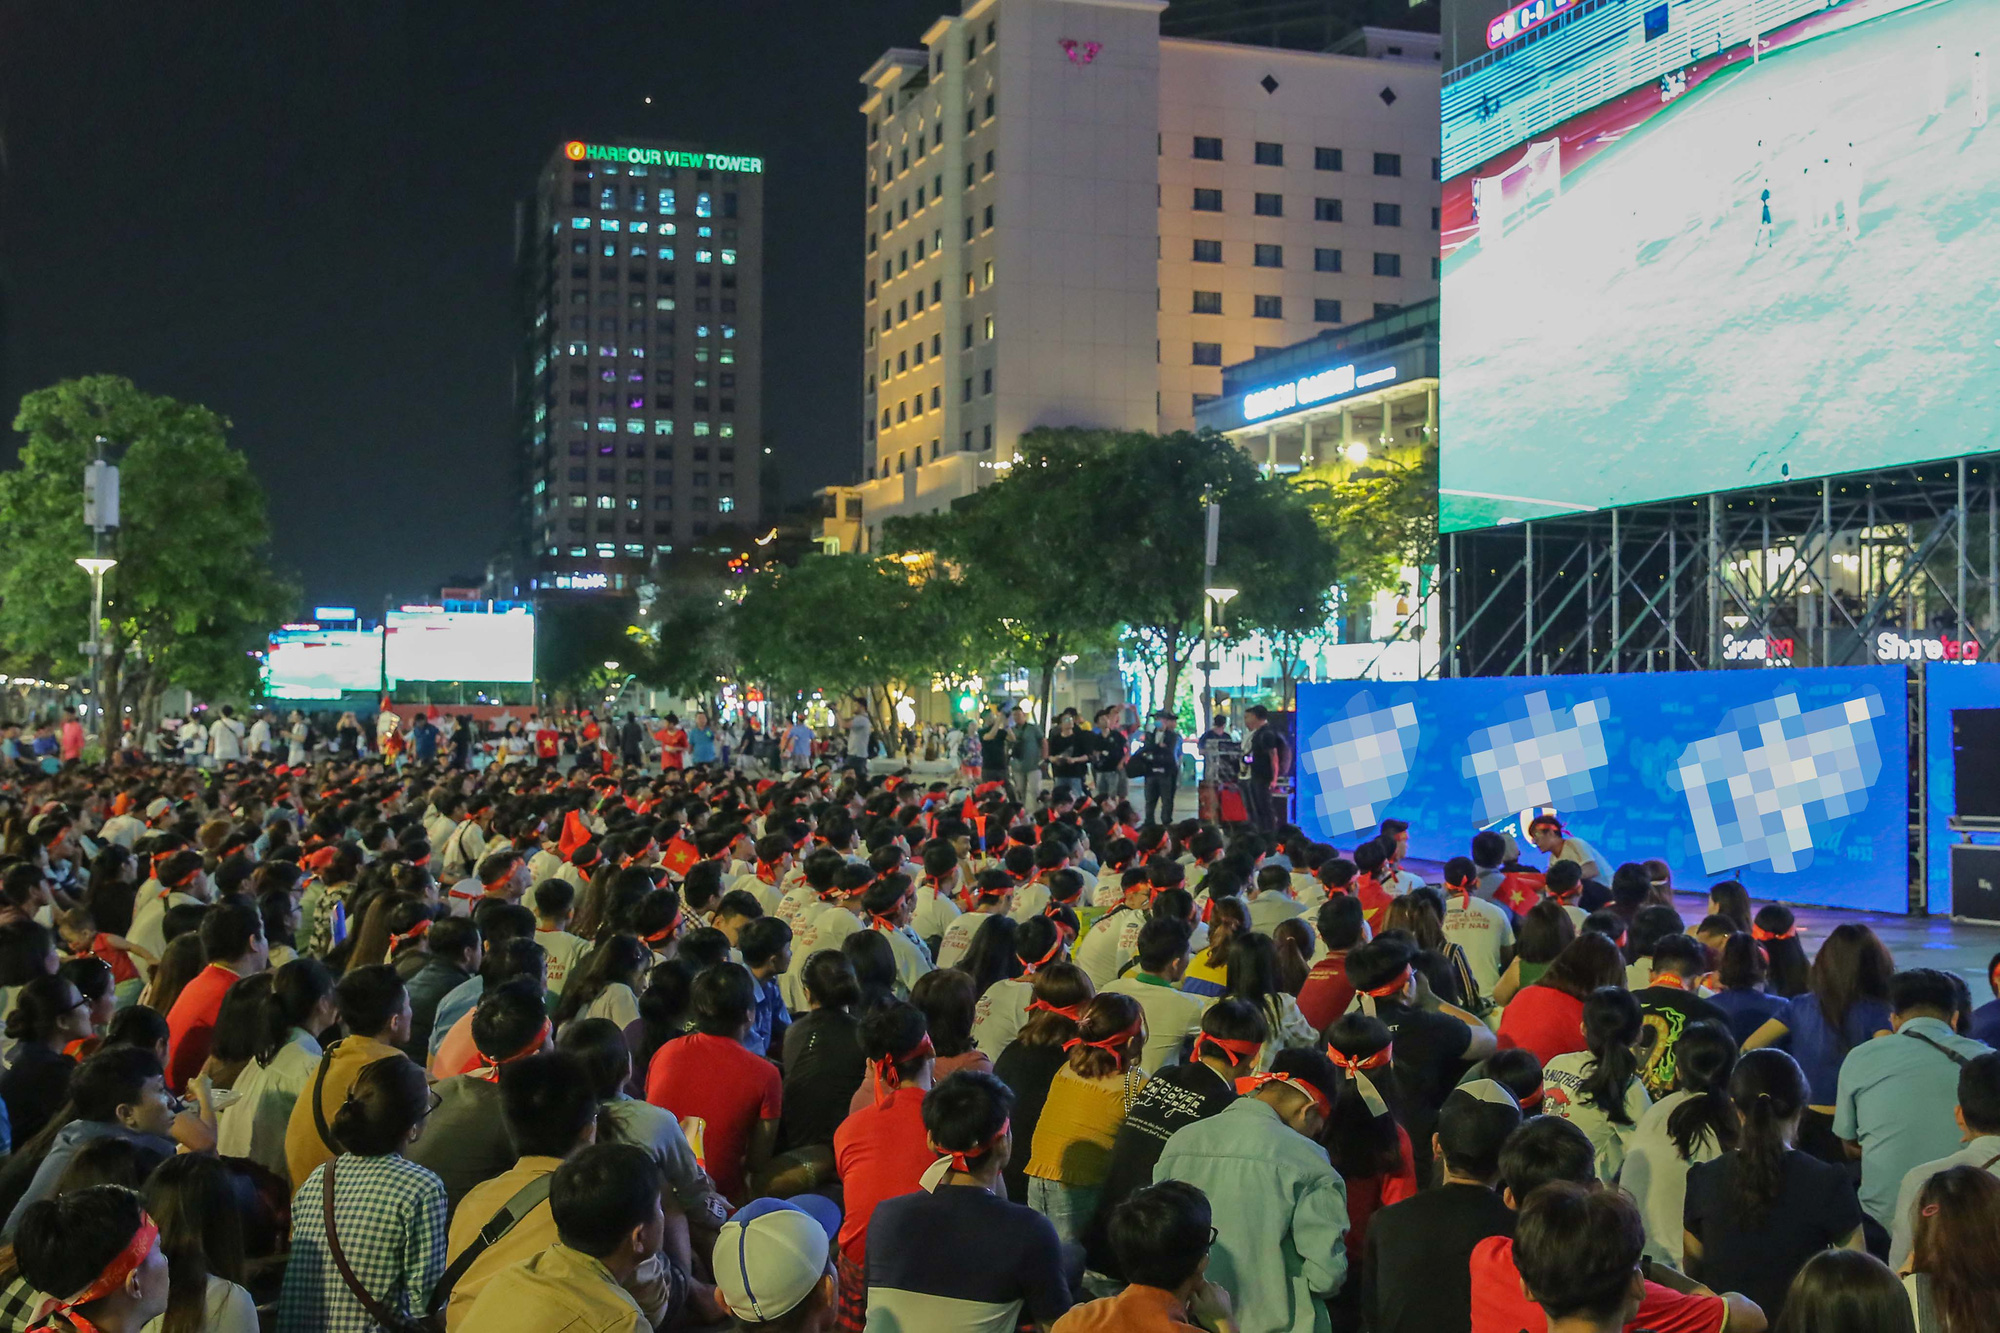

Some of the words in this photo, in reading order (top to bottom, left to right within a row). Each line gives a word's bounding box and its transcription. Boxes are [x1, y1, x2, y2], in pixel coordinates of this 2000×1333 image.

[586, 144, 661, 165] HARBOUR
[664, 150, 704, 168] VIEW
[705, 153, 762, 173] TOWER
